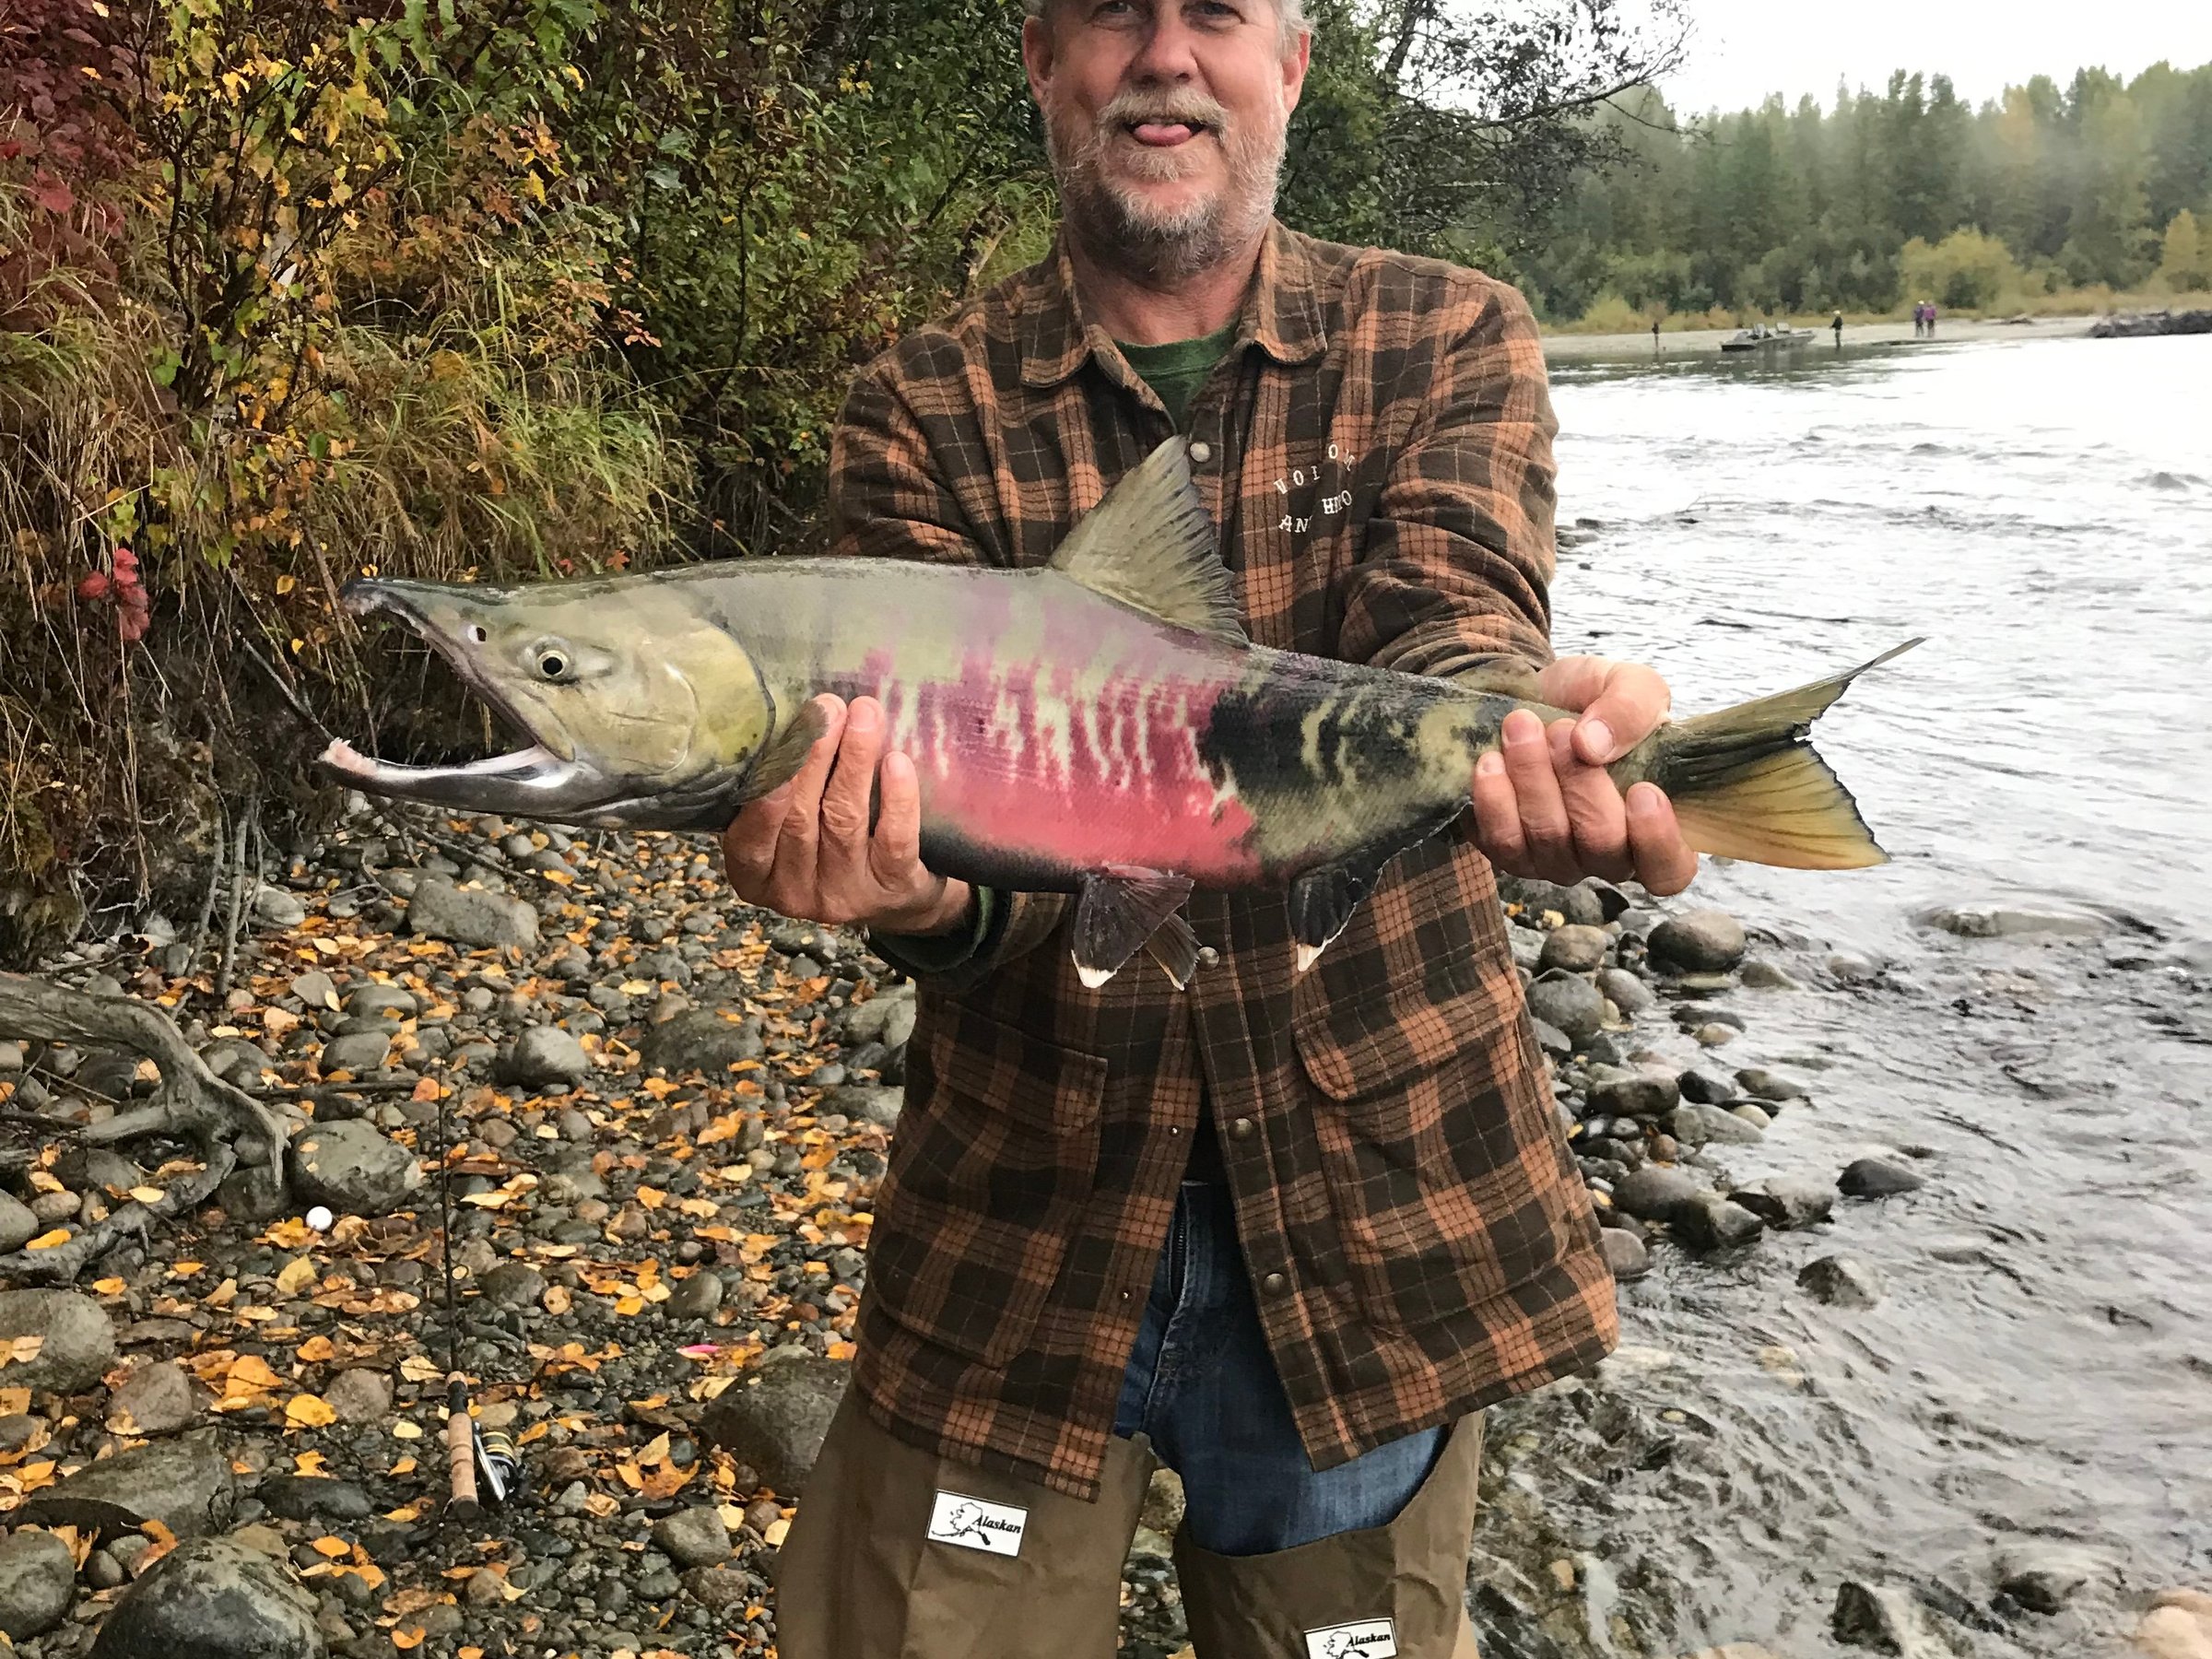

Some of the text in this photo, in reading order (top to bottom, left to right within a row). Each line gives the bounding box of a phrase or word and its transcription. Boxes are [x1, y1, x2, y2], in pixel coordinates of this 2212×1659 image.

[1278, 489, 1353, 533] AN HO
[971, 1514, 1022, 1535] Alaskan
[1346, 1632, 1391, 1648] Alaskan
